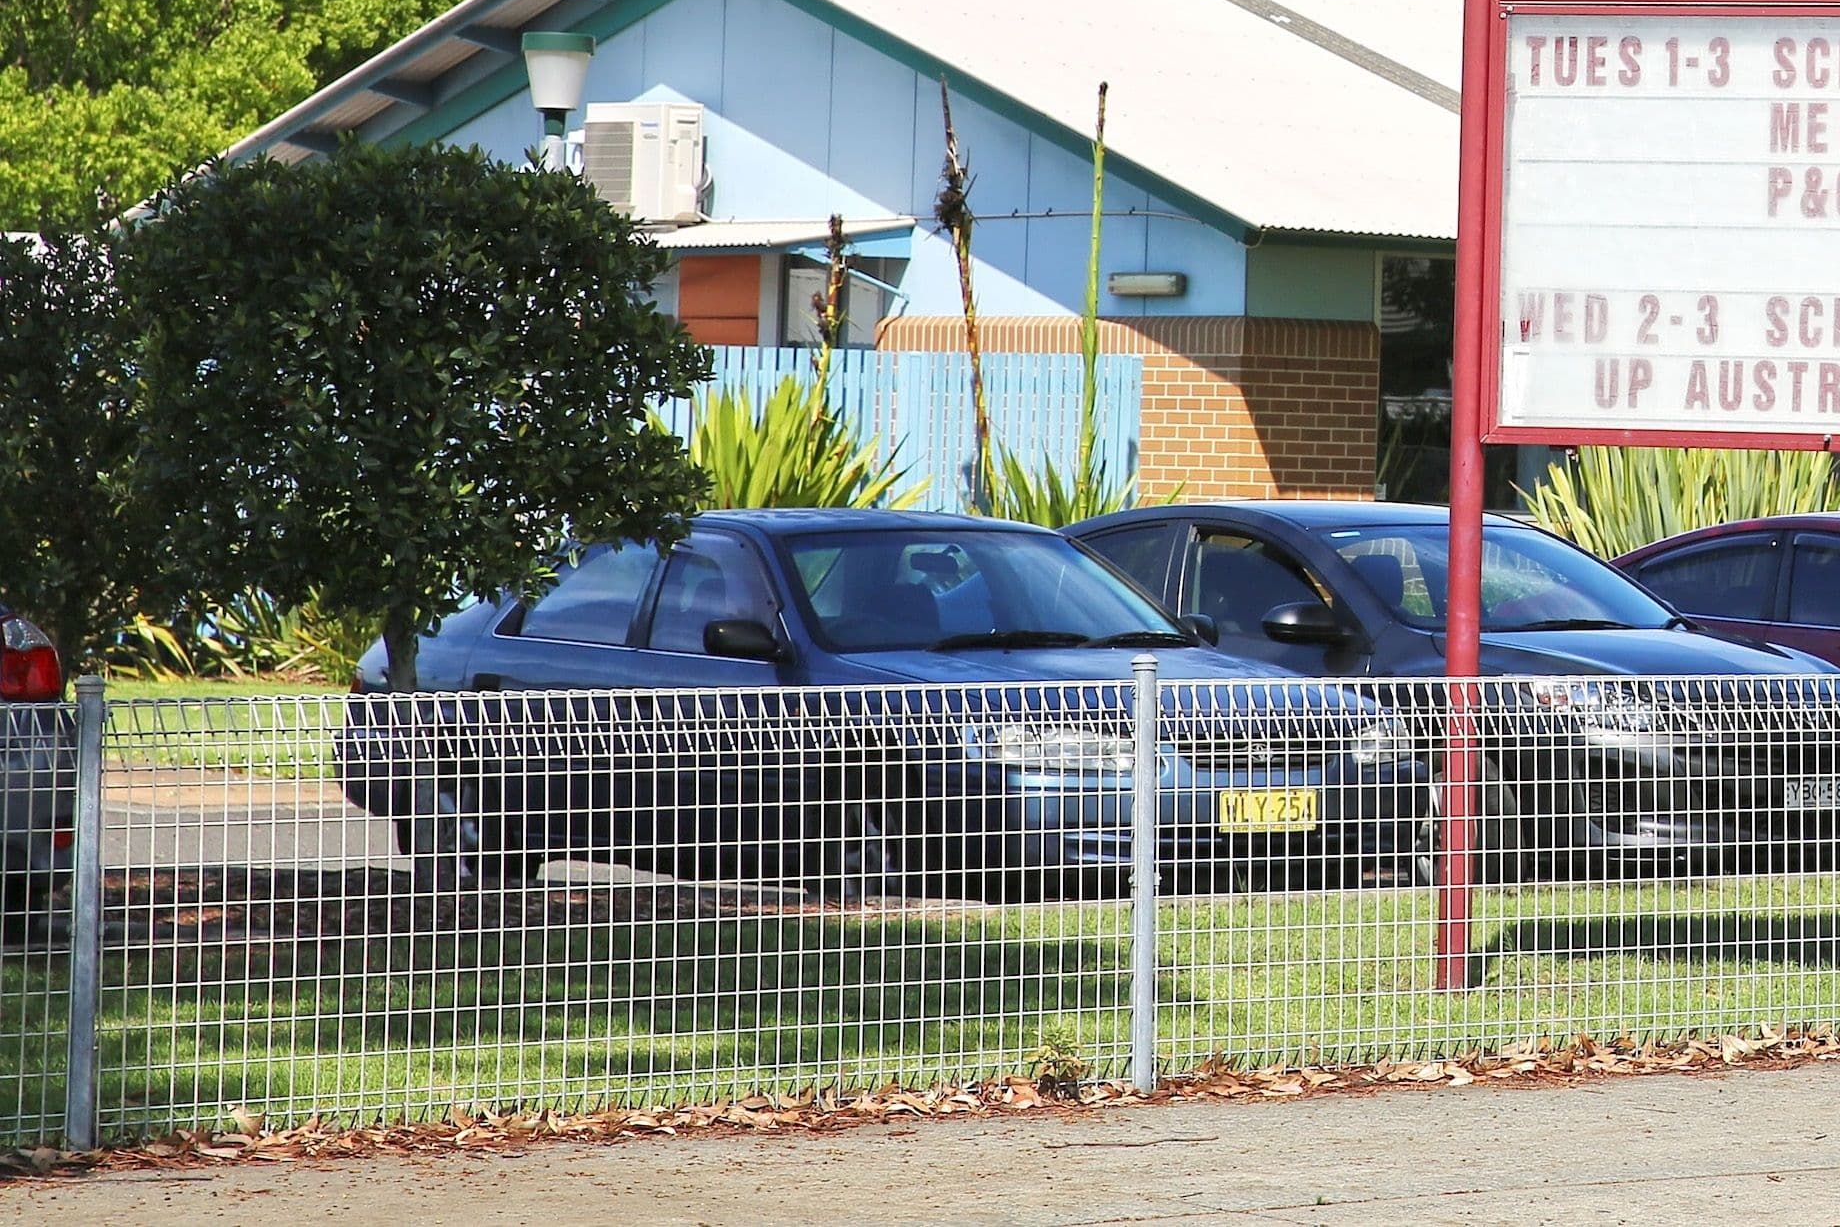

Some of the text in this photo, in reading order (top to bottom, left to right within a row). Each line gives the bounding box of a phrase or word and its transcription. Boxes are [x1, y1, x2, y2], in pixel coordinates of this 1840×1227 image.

[1526, 35, 1643, 88] TUES
[1665, 36, 1732, 88] 1-3
[1518, 293, 1610, 344] WED
[1637, 294, 1721, 345] 2-3
[1594, 359, 1654, 410] UP
